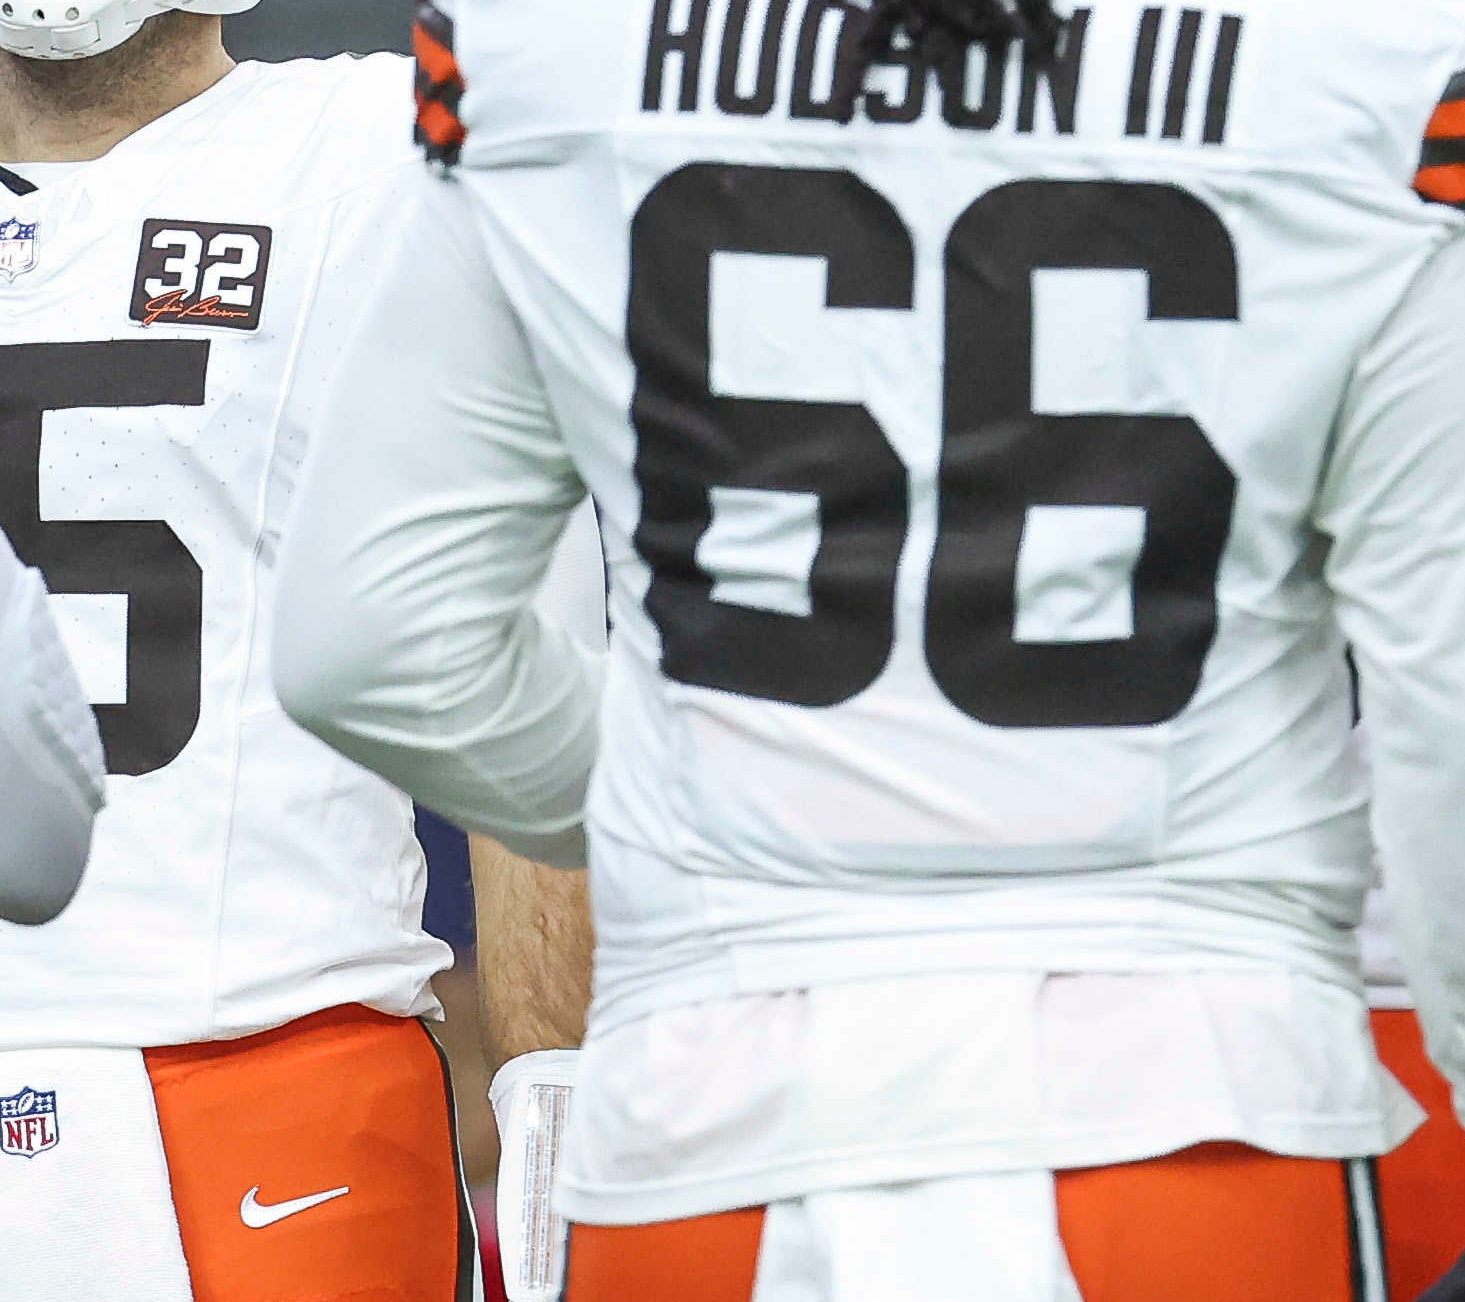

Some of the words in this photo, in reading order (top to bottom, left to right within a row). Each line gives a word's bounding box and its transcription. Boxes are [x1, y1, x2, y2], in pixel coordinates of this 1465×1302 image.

[1125, 7, 1244, 144] III
[143, 229, 260, 307] 32
[628, 161, 1240, 728] 66
[4, 1117, 54, 1151] NFL
